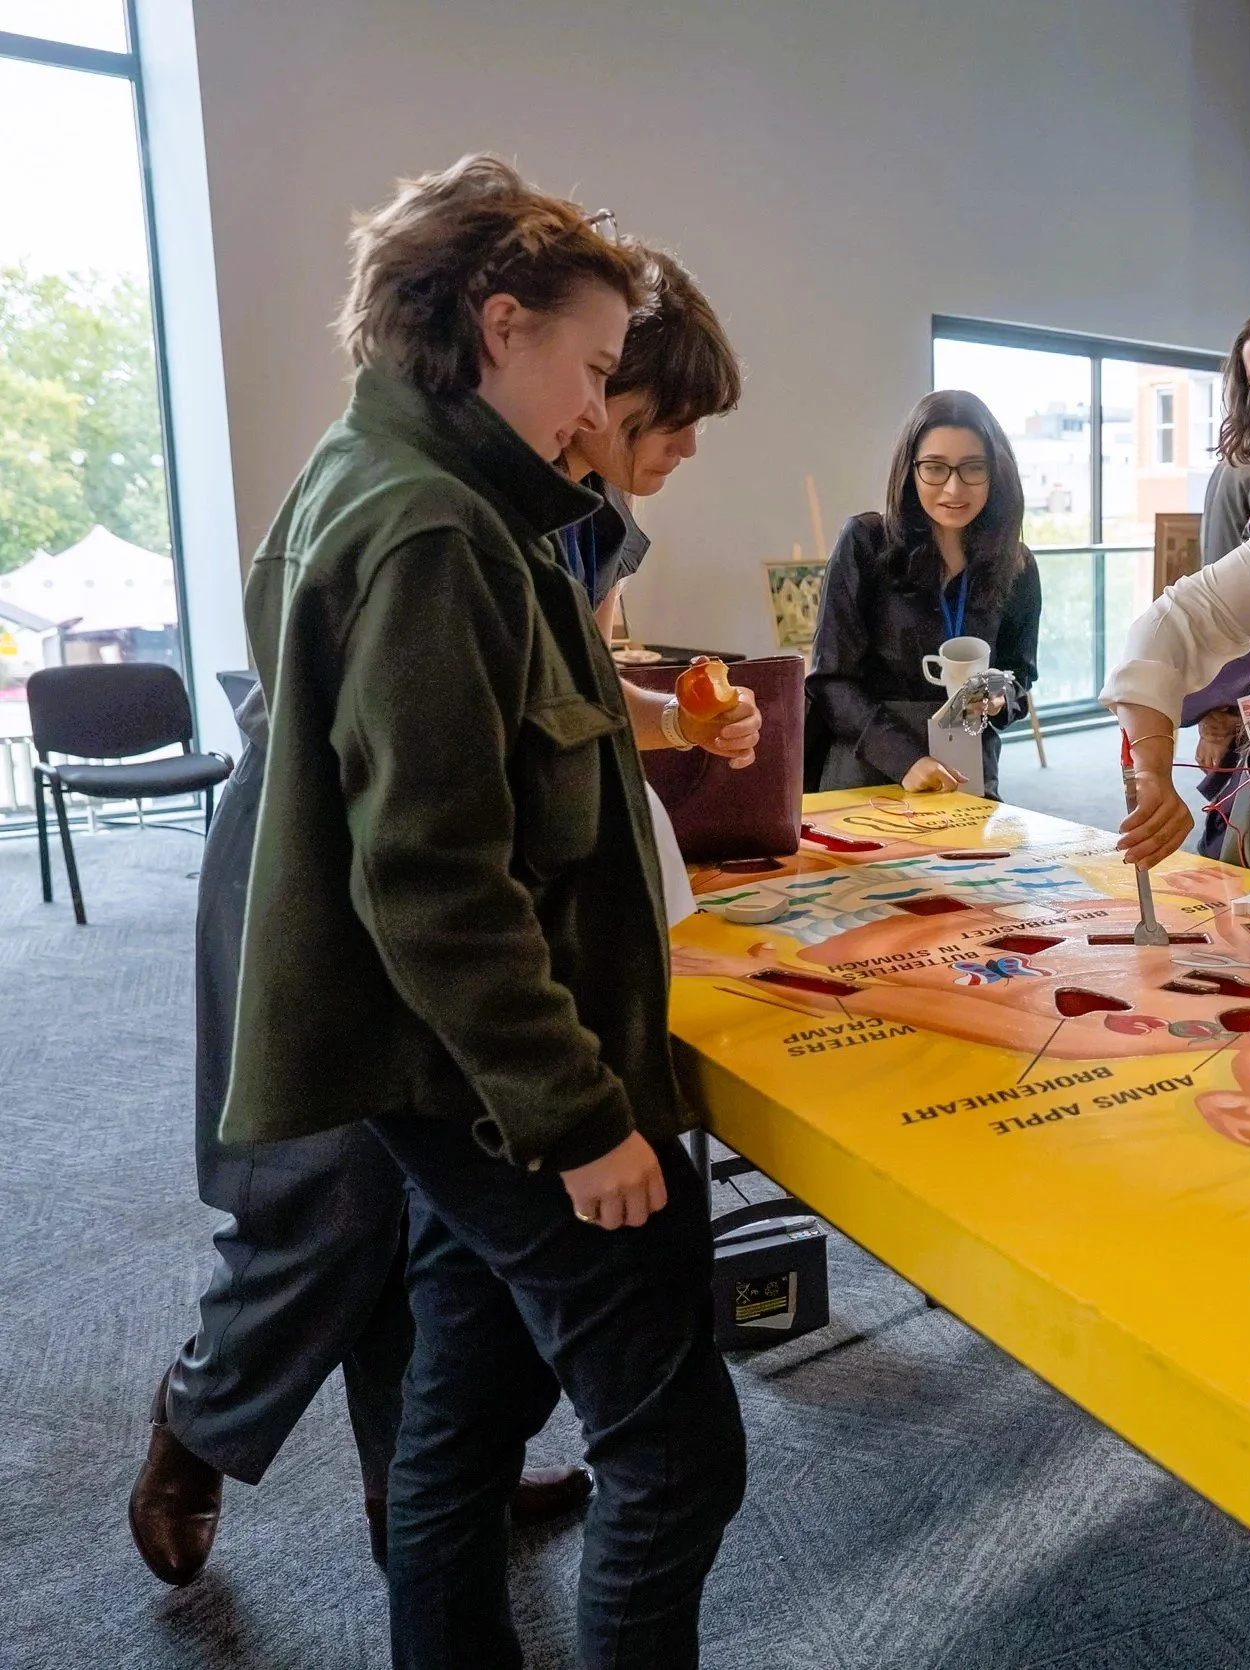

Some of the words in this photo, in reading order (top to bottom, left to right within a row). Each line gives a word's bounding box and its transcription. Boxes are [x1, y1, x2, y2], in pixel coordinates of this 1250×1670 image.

[1181, 901, 1228, 914] RIBS
[960, 910, 1110, 939] BREADBASKET
[827, 949, 932, 974] STOMACH
[938, 944, 962, 954] IN
[842, 951, 980, 982] BUTTERFLIES
[783, 1017, 884, 1045] CRAMP
[787, 1024, 917, 1057] WRITERS
[901, 1066, 1115, 1126] BROKENHEART
[1092, 1074, 1196, 1109] ADAMS
[988, 1102, 1082, 1136] APPLE
